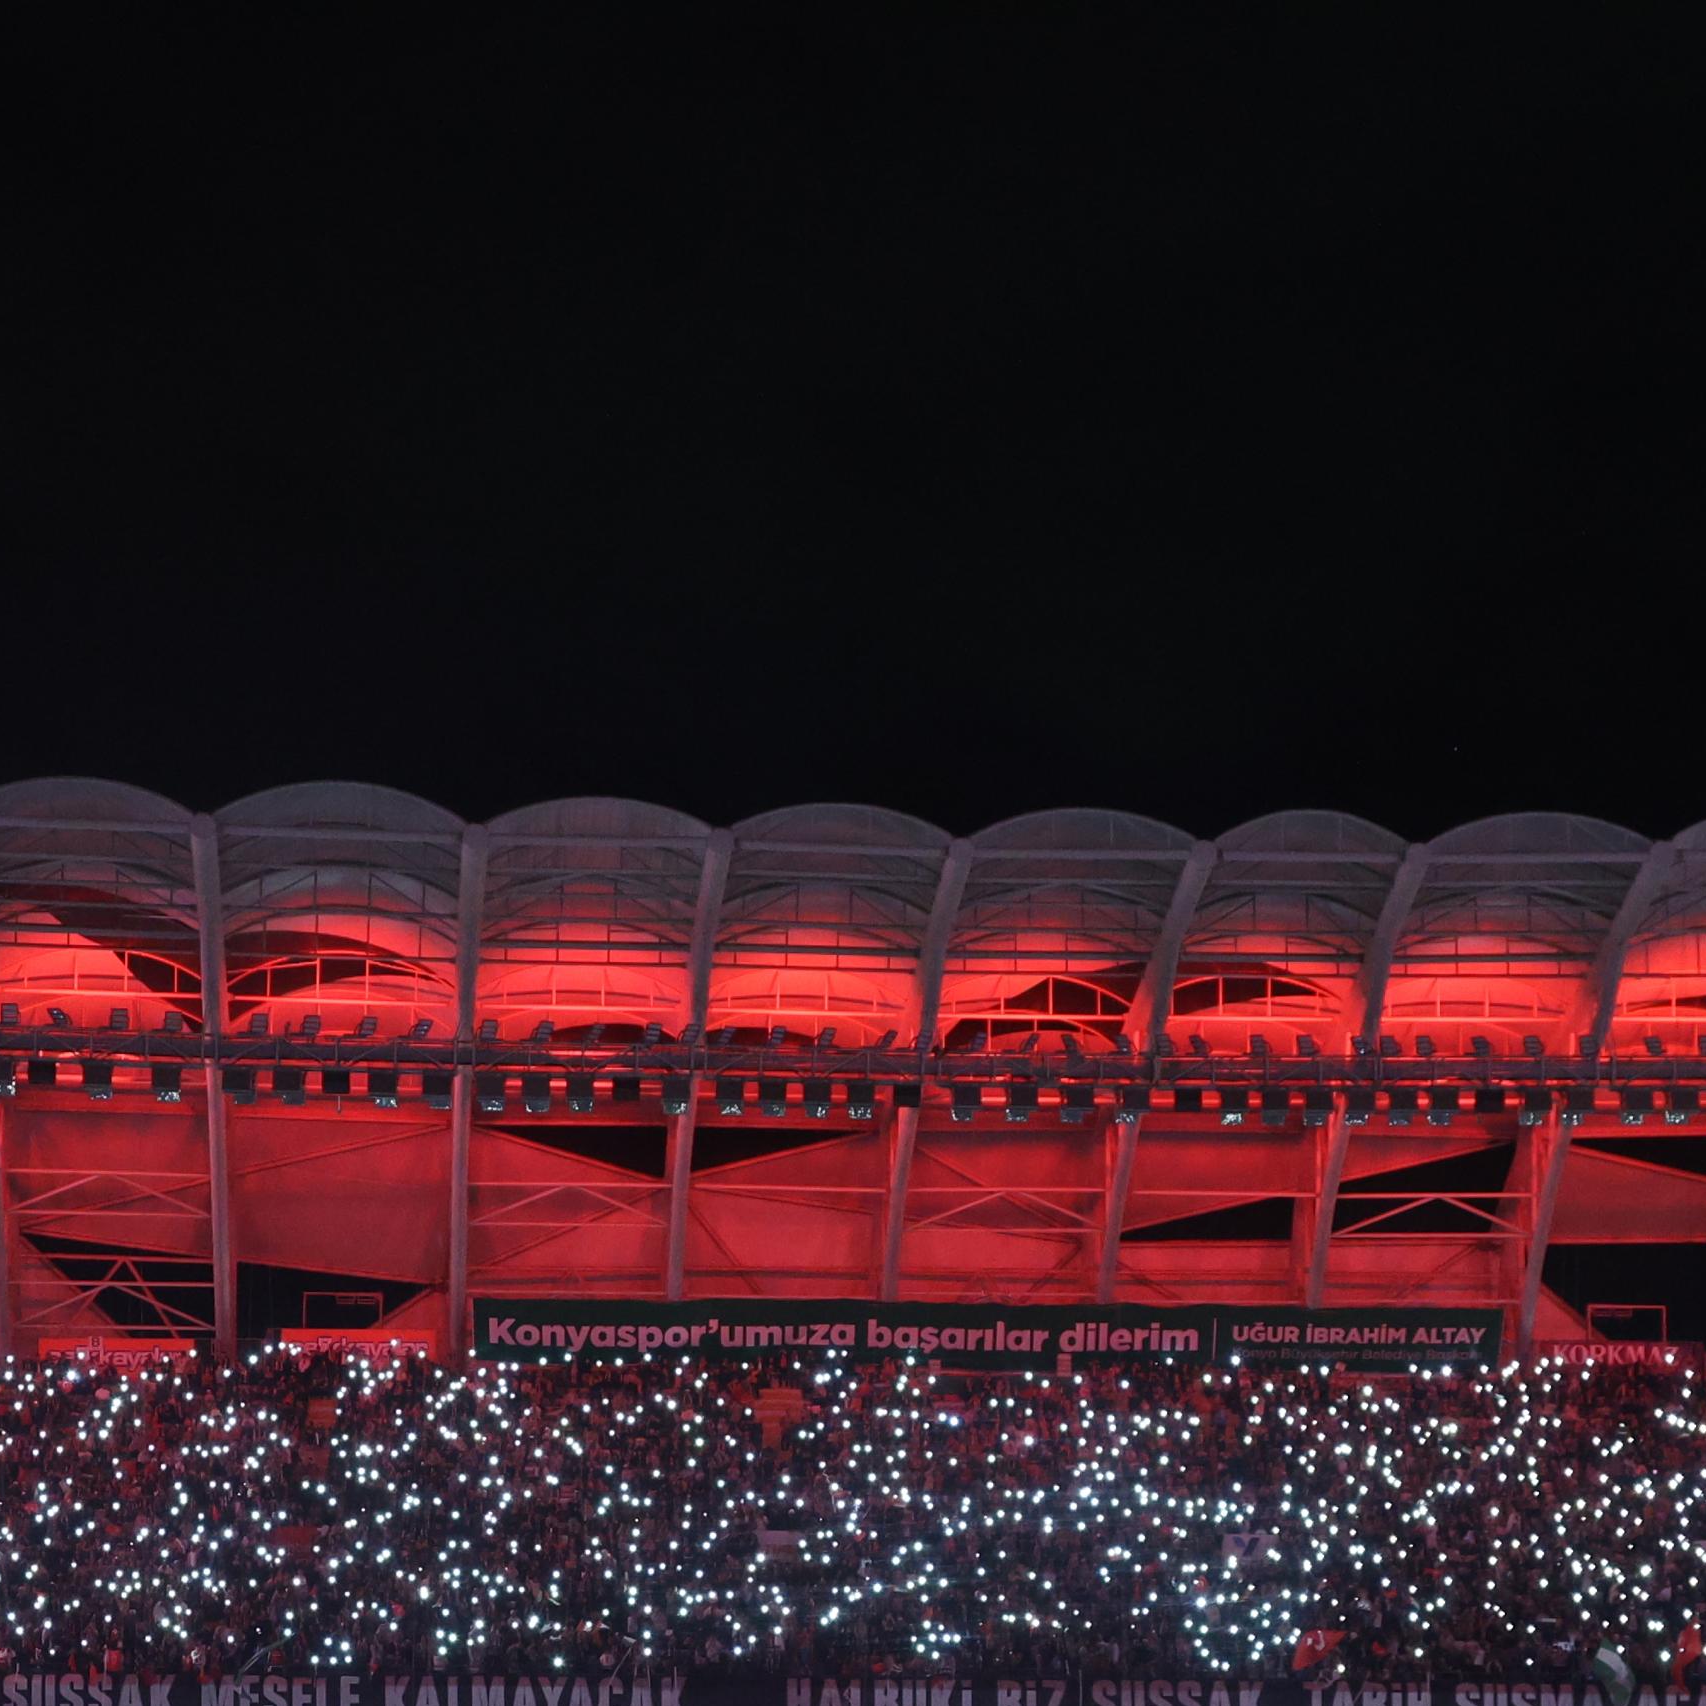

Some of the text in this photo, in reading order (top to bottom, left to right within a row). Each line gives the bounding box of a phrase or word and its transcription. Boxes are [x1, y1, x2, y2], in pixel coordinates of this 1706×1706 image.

[867, 1319, 1050, 1353] başarılar
[1059, 1322, 1200, 1352] dilerim
[1232, 1322, 1301, 1345] UĞUR
[1306, 1323, 1406, 1345] İBRAHİM
[1411, 1326, 1488, 1345] ALTAY
